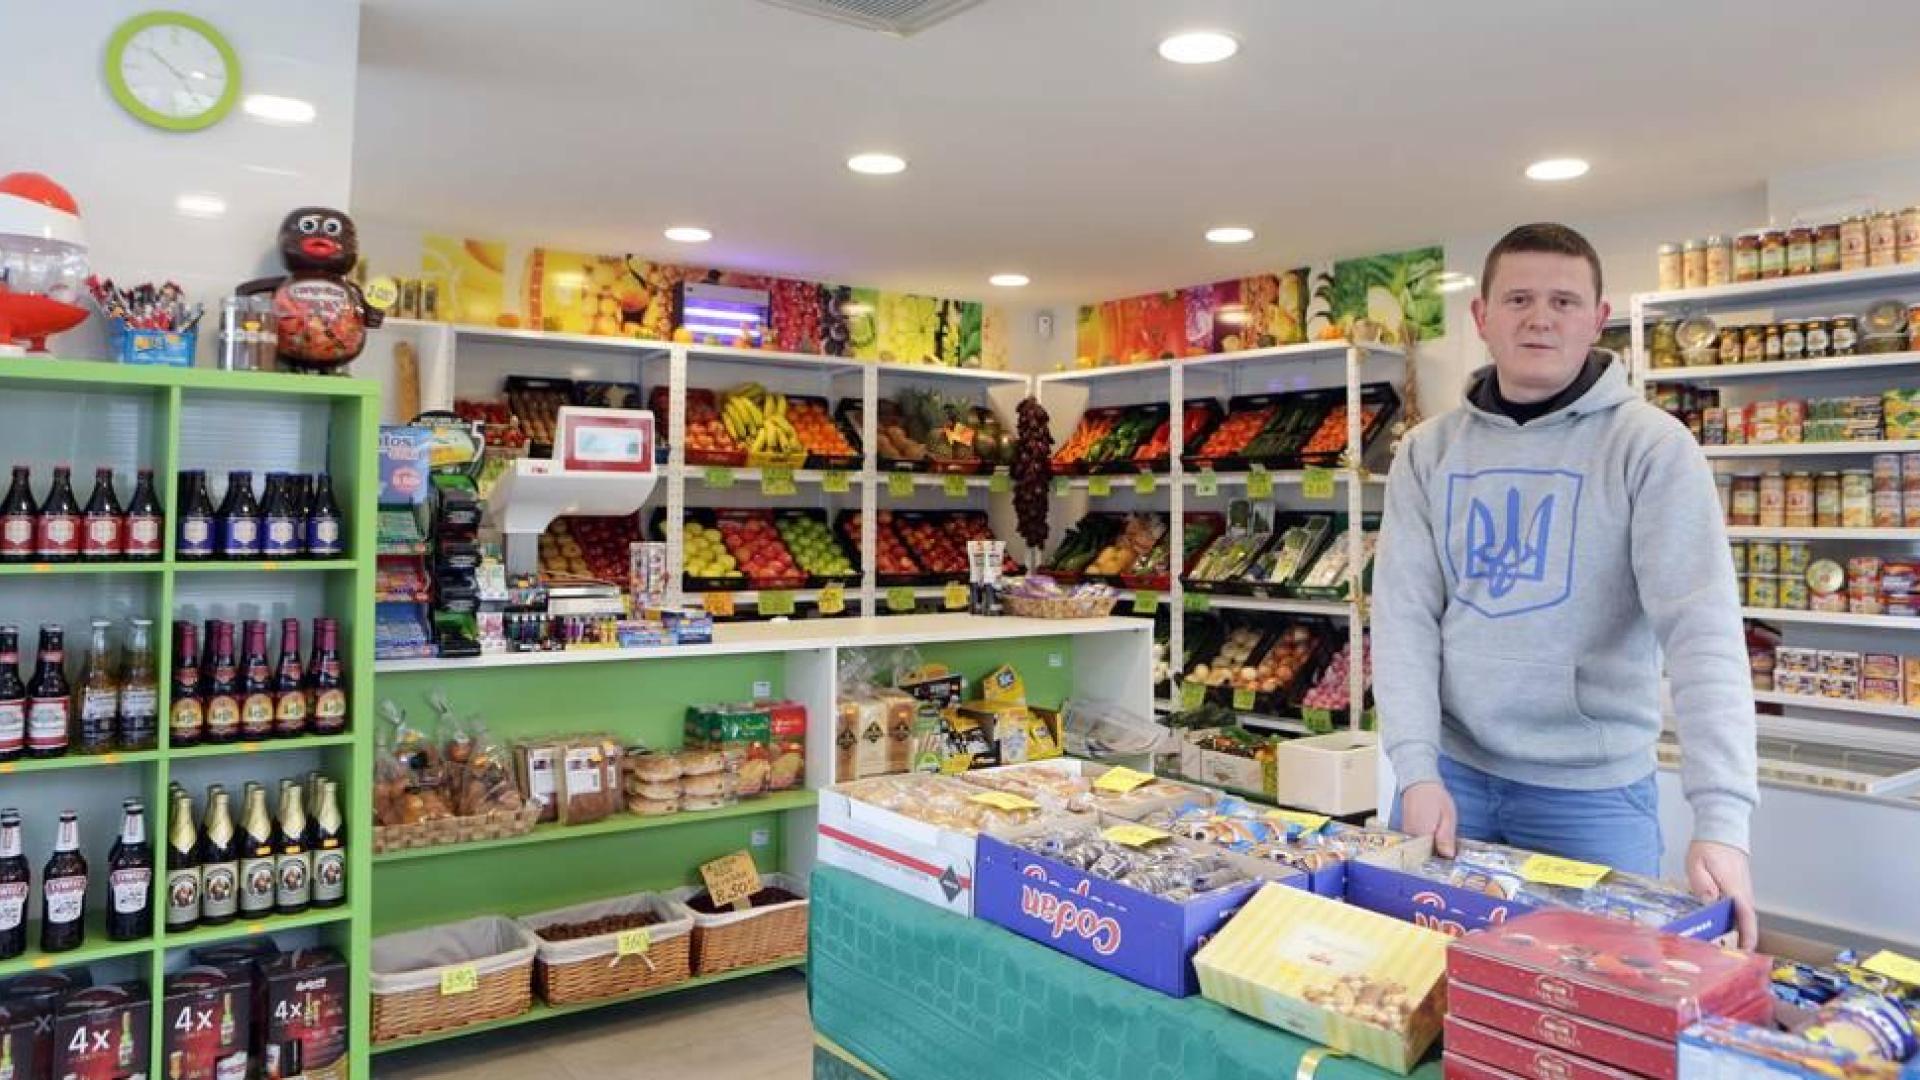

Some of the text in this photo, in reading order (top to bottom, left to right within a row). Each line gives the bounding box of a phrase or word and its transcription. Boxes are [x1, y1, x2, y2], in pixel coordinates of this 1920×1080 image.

[1022, 884, 1122, 955] Codan
[174, 1005, 214, 1032] 4x
[274, 1000, 303, 1021] 4x
[67, 1025, 111, 1054] 4x
